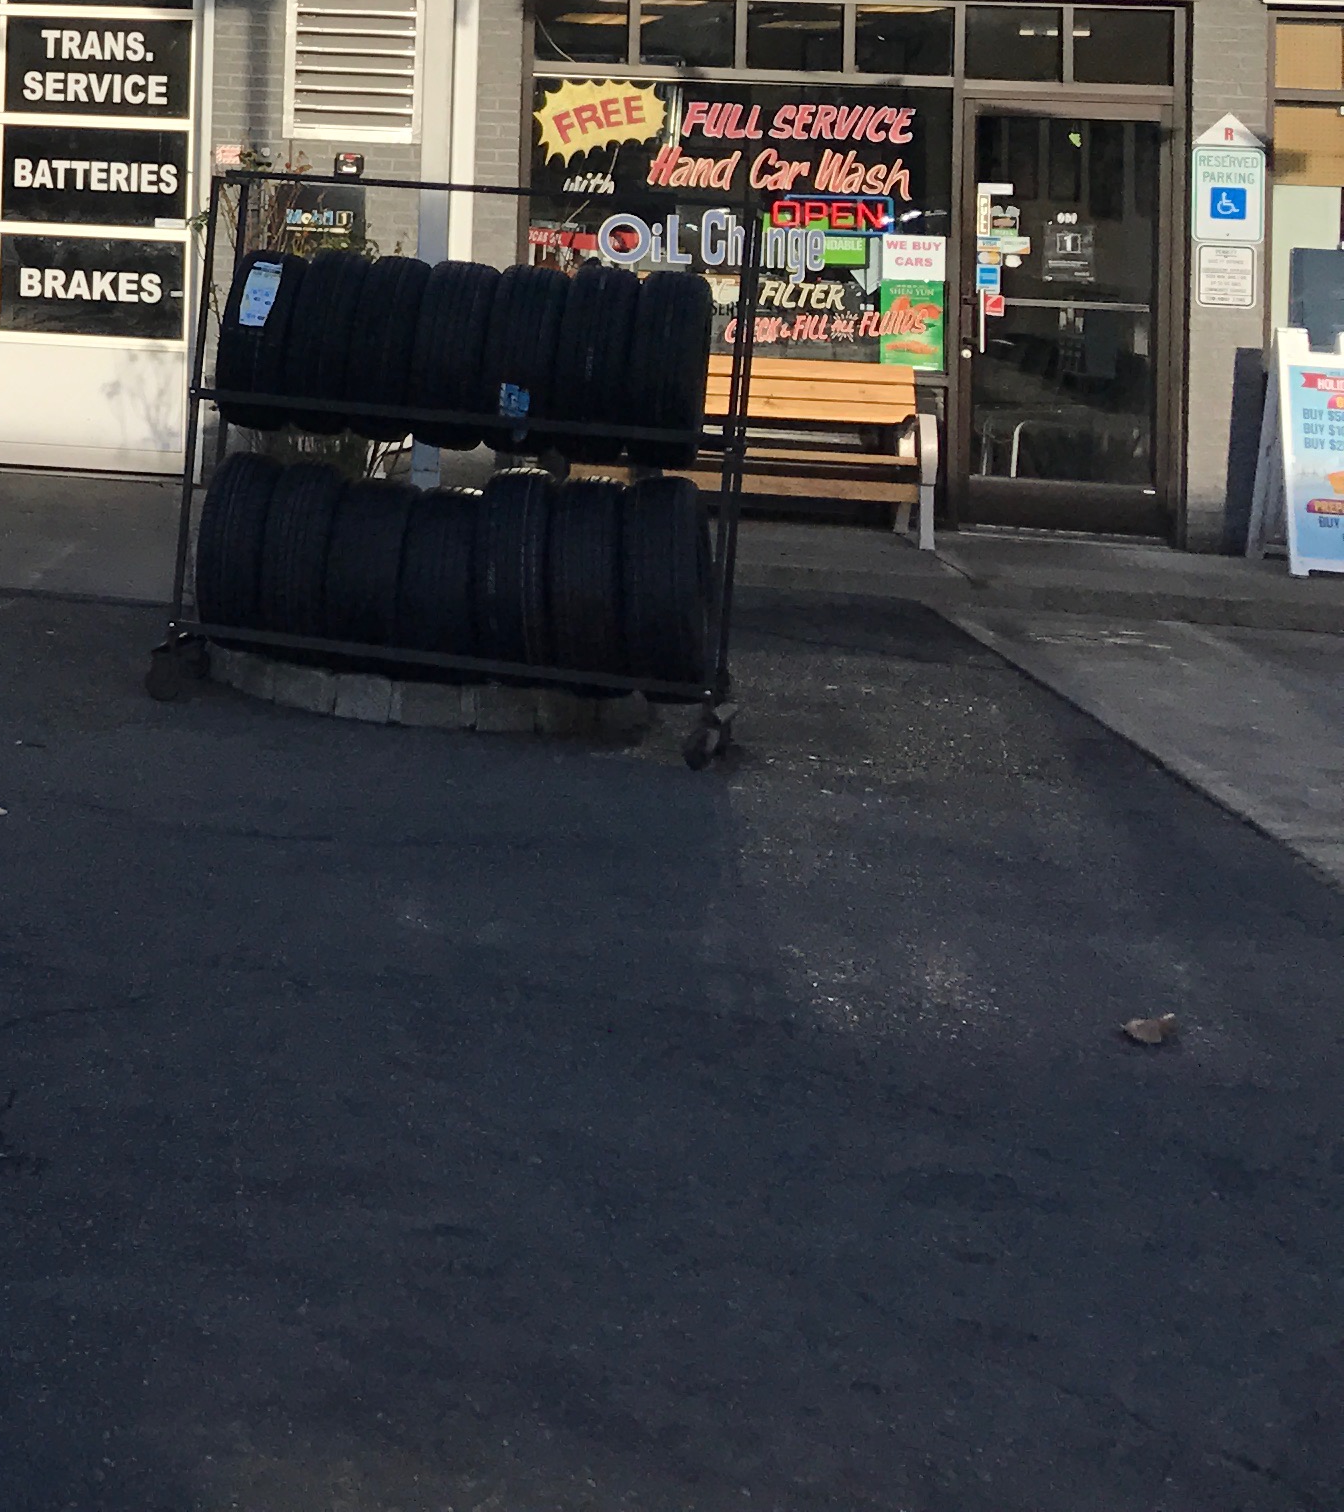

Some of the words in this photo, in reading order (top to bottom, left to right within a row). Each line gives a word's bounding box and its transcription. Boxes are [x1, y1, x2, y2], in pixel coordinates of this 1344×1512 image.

[41, 30, 154, 62] TRANS.
[23, 71, 168, 105] SERVICE
[552, 94, 646, 145] FREE
[681, 101, 764, 139] FULL
[768, 104, 916, 144] SERVICE
[1224, 127, 1234, 141] R
[14, 158, 178, 194] BATTERIES
[646, 143, 742, 191] Hand
[749, 148, 811, 191] Car
[814, 148, 913, 201] Wash
[1198, 155, 1259, 169] RESERVED
[562, 172, 615, 194] with
[1202, 171, 1256, 185] PARKING
[771, 200, 885, 228] OPEN
[701, 208, 826, 284] Chnge
[886, 240, 908, 250] WE
[912, 240, 943, 251] BUY
[894, 256, 934, 267] CARS
[19, 268, 162, 304] BRAKES
[758, 280, 846, 311] FILTER
[724, 316, 782, 344] CECK
[792, 312, 829, 341] FILL
[859, 309, 930, 337] FLUIDS
[1302, 408, 1324, 420] BUY
[1303, 423, 1325, 435] BUY
[1304, 437, 1326, 450] BUY
[1329, 438, 1344, 452] $2
[1318, 516, 1340, 528] BUY
